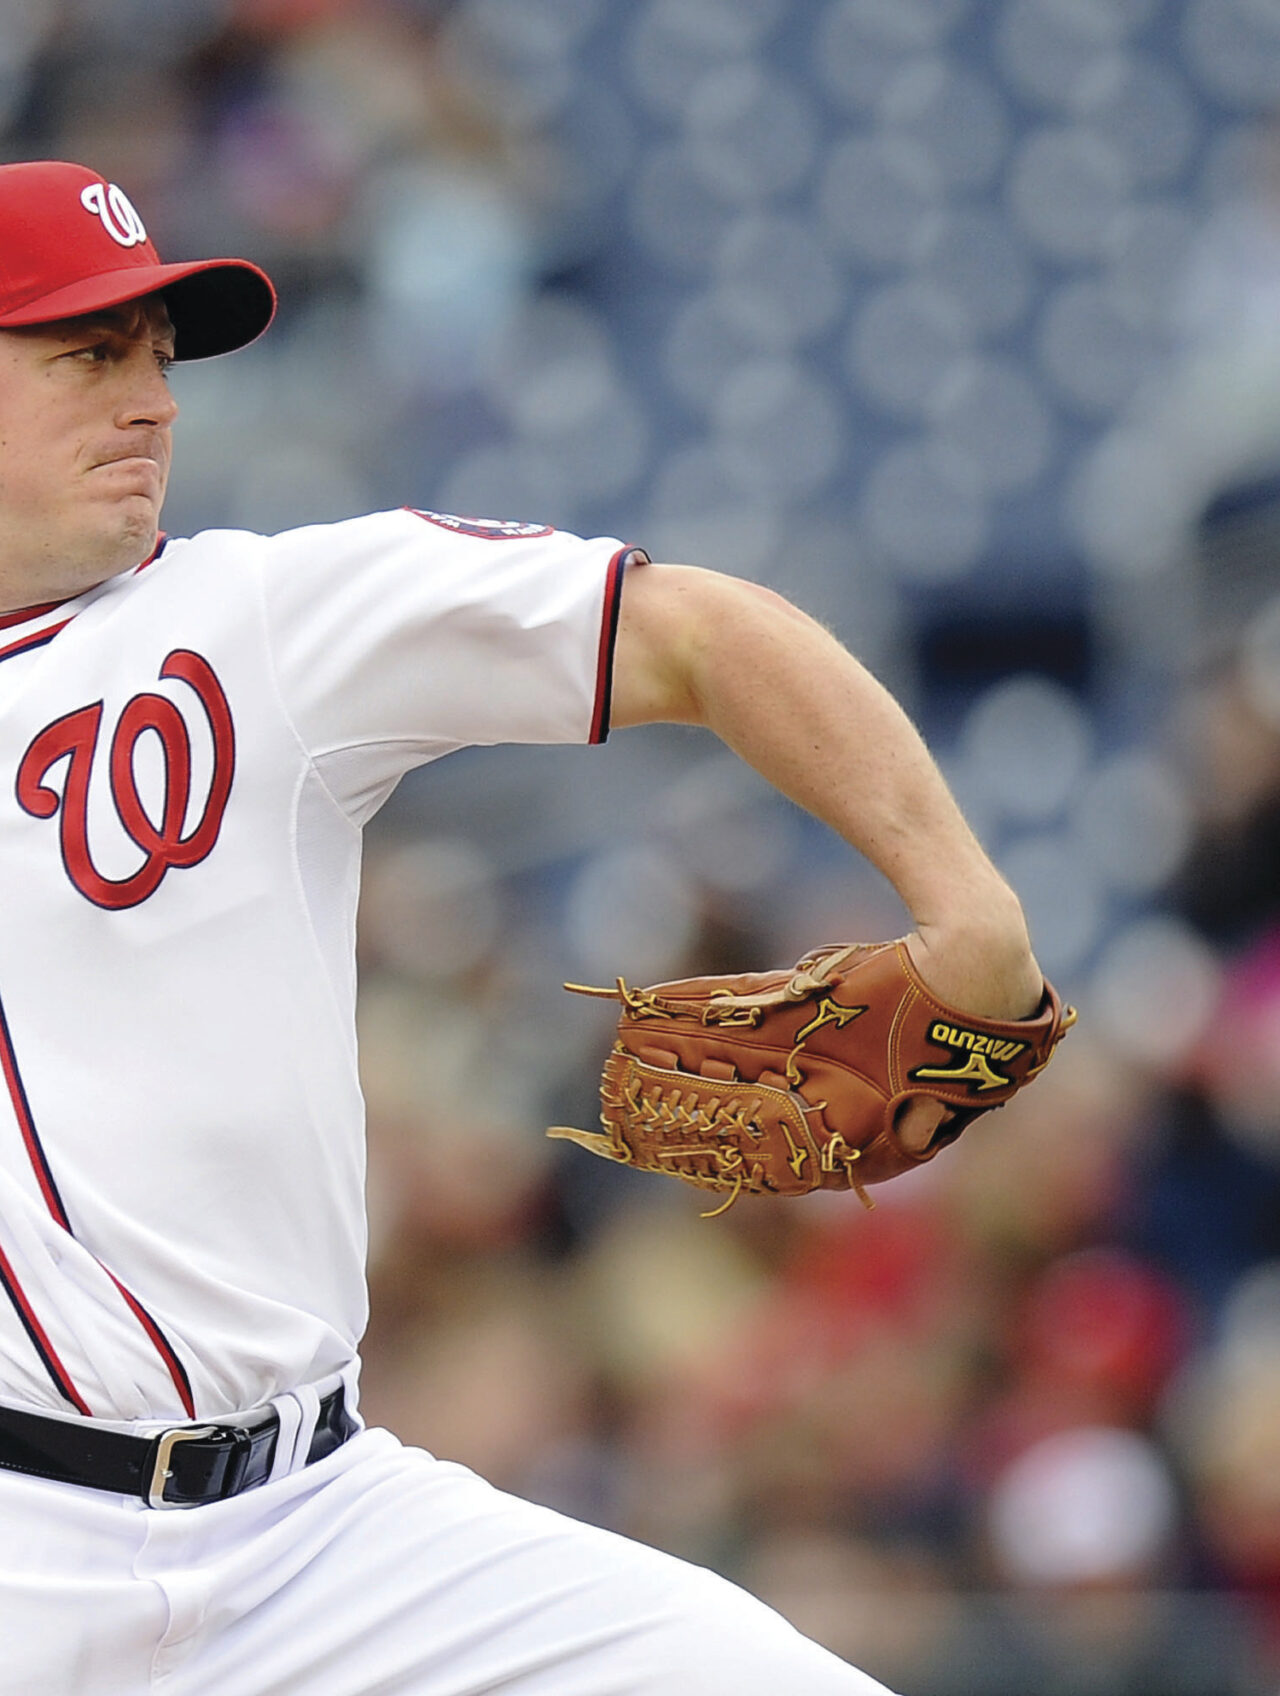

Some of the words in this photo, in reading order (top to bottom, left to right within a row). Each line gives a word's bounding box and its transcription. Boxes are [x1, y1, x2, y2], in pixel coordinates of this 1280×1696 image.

[80, 182, 147, 247] W
[14, 648, 236, 911] W
[932, 1023, 1025, 1061] MIZUNO
